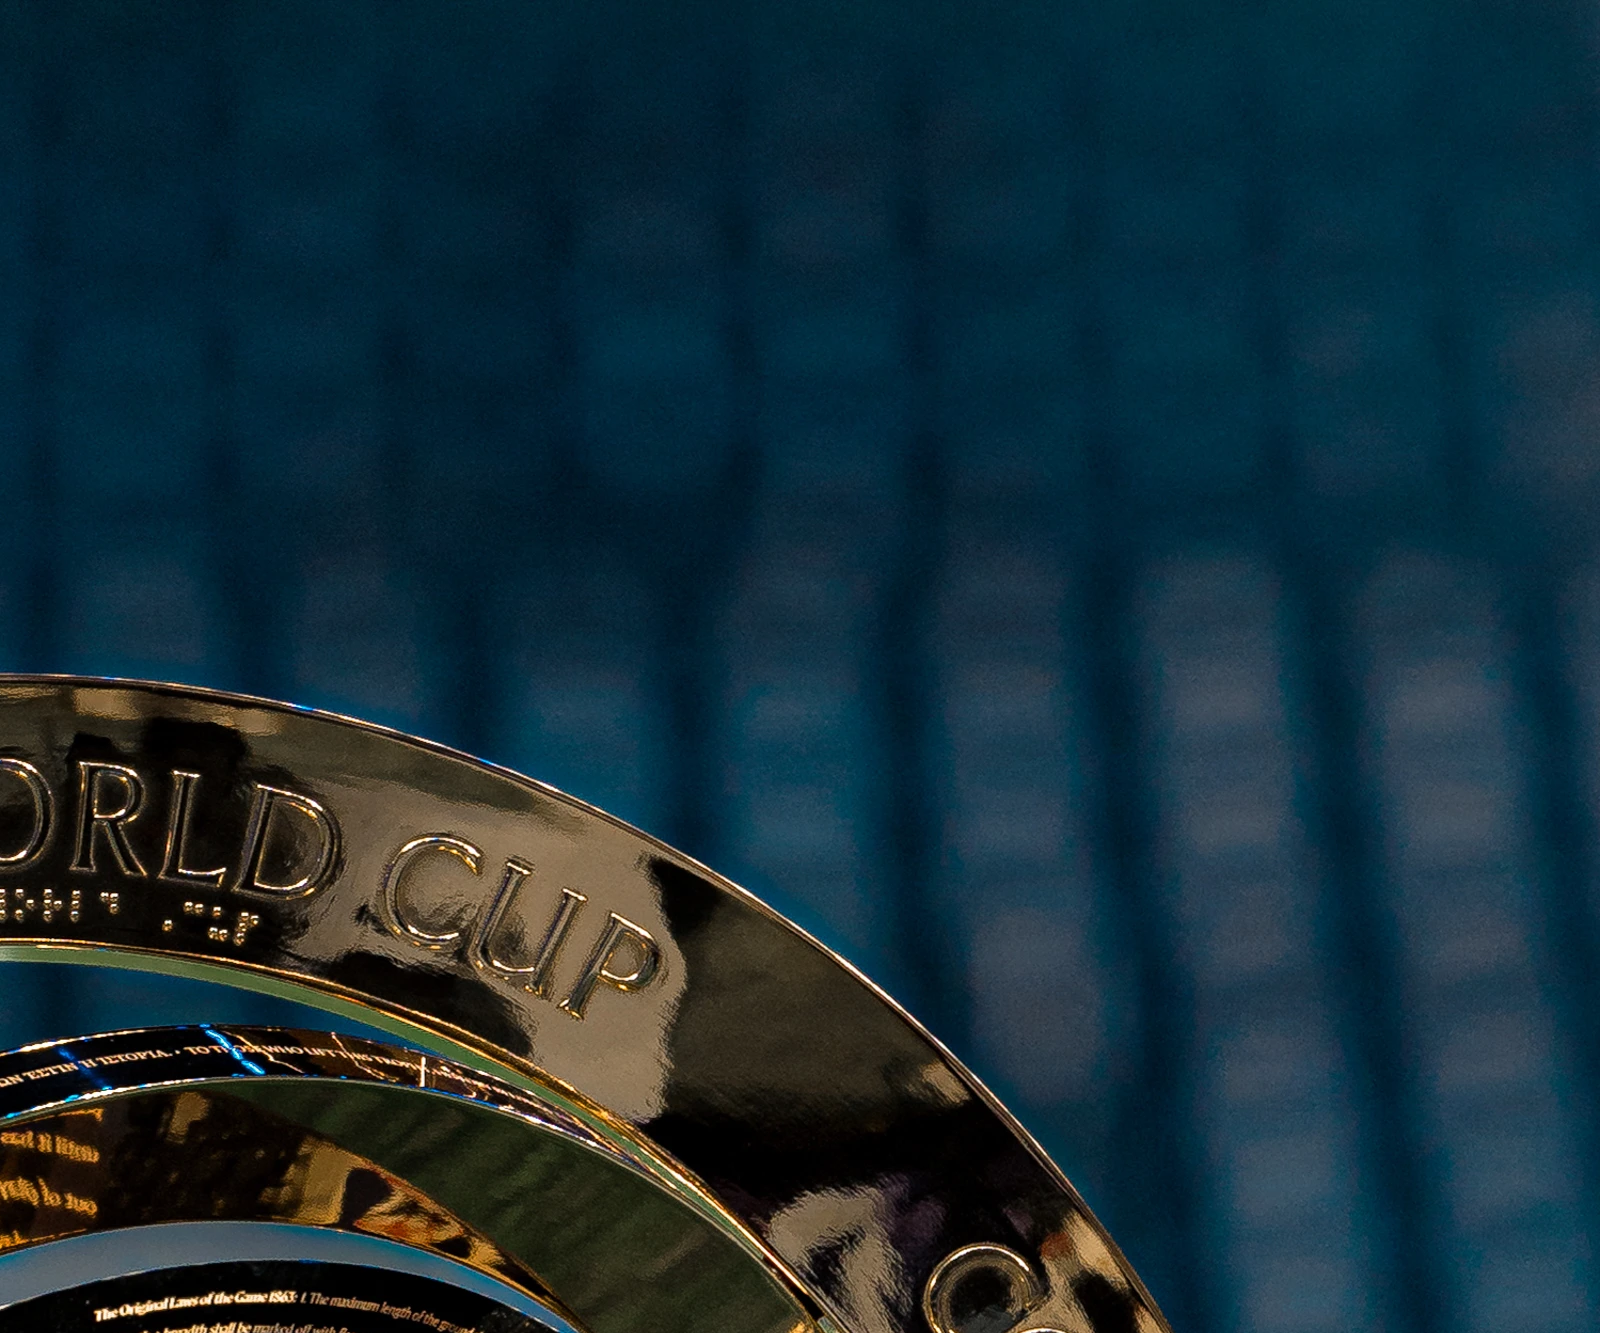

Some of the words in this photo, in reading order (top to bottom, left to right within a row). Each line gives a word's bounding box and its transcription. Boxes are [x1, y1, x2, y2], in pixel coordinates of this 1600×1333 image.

[383, 832, 663, 1020] CUP
[183, 1045, 210, 1055] TO
[208, 1044, 262, 1054] TOSE
[262, 1045, 303, 1054] WHO
[93, 1307, 119, 1322] The
[117, 1296, 168, 1317] Original
[168, 1295, 200, 1309] Laws
[198, 1290, 215, 1306] of
[212, 1291, 234, 1305] the
[233, 1290, 268, 1303] Game
[267, 1289, 297, 1303] 1863:
[309, 1291, 329, 1305] The
[328, 1296, 379, 1312] maximum
[379, 1300, 412, 1320] length
[411, 1309, 427, 1323] of
[422, 1312, 440, 1328] the
[235, 1321, 252, 1333] be
